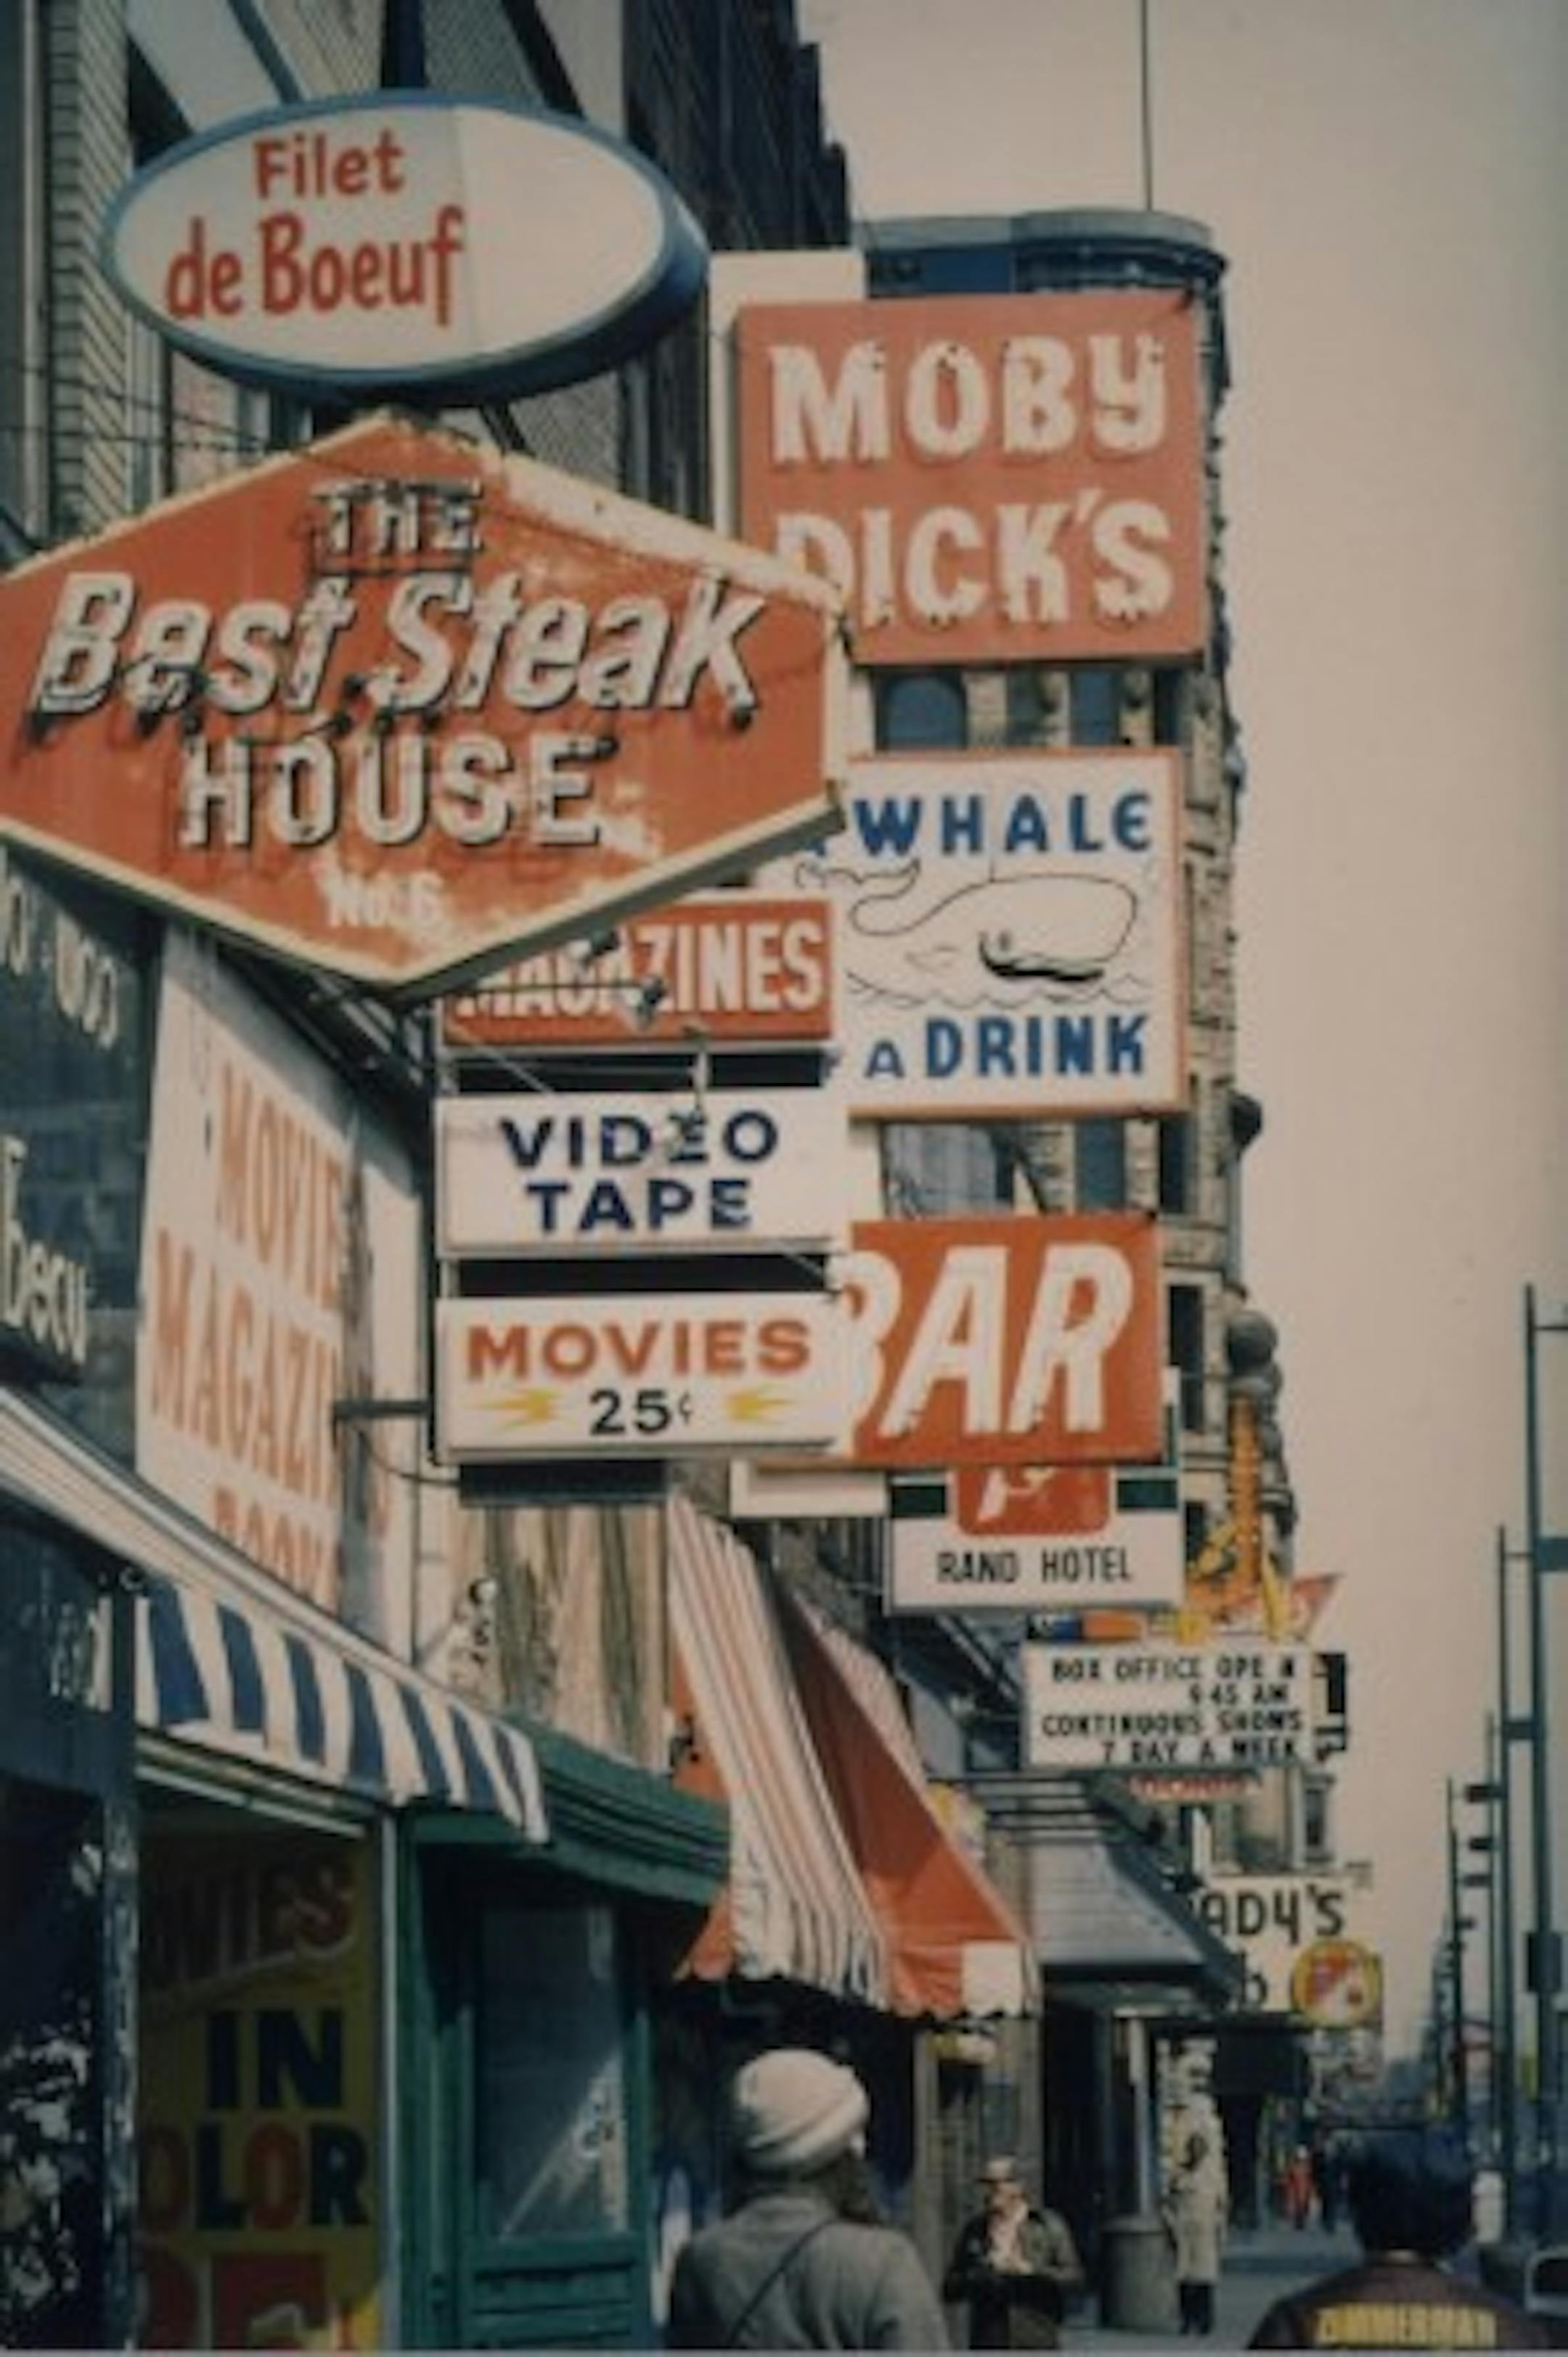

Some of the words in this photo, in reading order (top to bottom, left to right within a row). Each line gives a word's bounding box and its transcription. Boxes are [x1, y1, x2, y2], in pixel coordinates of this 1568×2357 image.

[252, 126, 406, 199] Filet
[166, 216, 242, 318] de
[258, 204, 465, 327] Boeuf
[767, 334, 1164, 462] MOBY
[312, 480, 483, 552] THE
[30, 572, 356, 714] Best
[377, 570, 764, 711] Steak
[181, 732, 601, 847] HOUSE
[852, 791, 1152, 854] WHALE
[864, 1040, 905, 1079] A
[925, 1014, 1148, 1079] DRINK
[499, 1110, 778, 1169] VIDEO
[525, 1179, 751, 1232] TAPE
[466, 1319, 812, 1381] MOVIES
[589, 1389, 693, 1436] 25¢
[1041, 1546, 1133, 1583] HOTEL
[1053, 1657, 1101, 1683] BOX
[1116, 1657, 1201, 1683] OFFICE
[1041, 1715, 1202, 1737] CONTINUOUS
[1217, 1709, 1302, 1734] SHOWS
[1103, 1740, 1115, 1763] 7
[1132, 1740, 1178, 1763] DAY
[1200, 1739, 1216, 1762] A
[204, 2009, 343, 2111] IN
